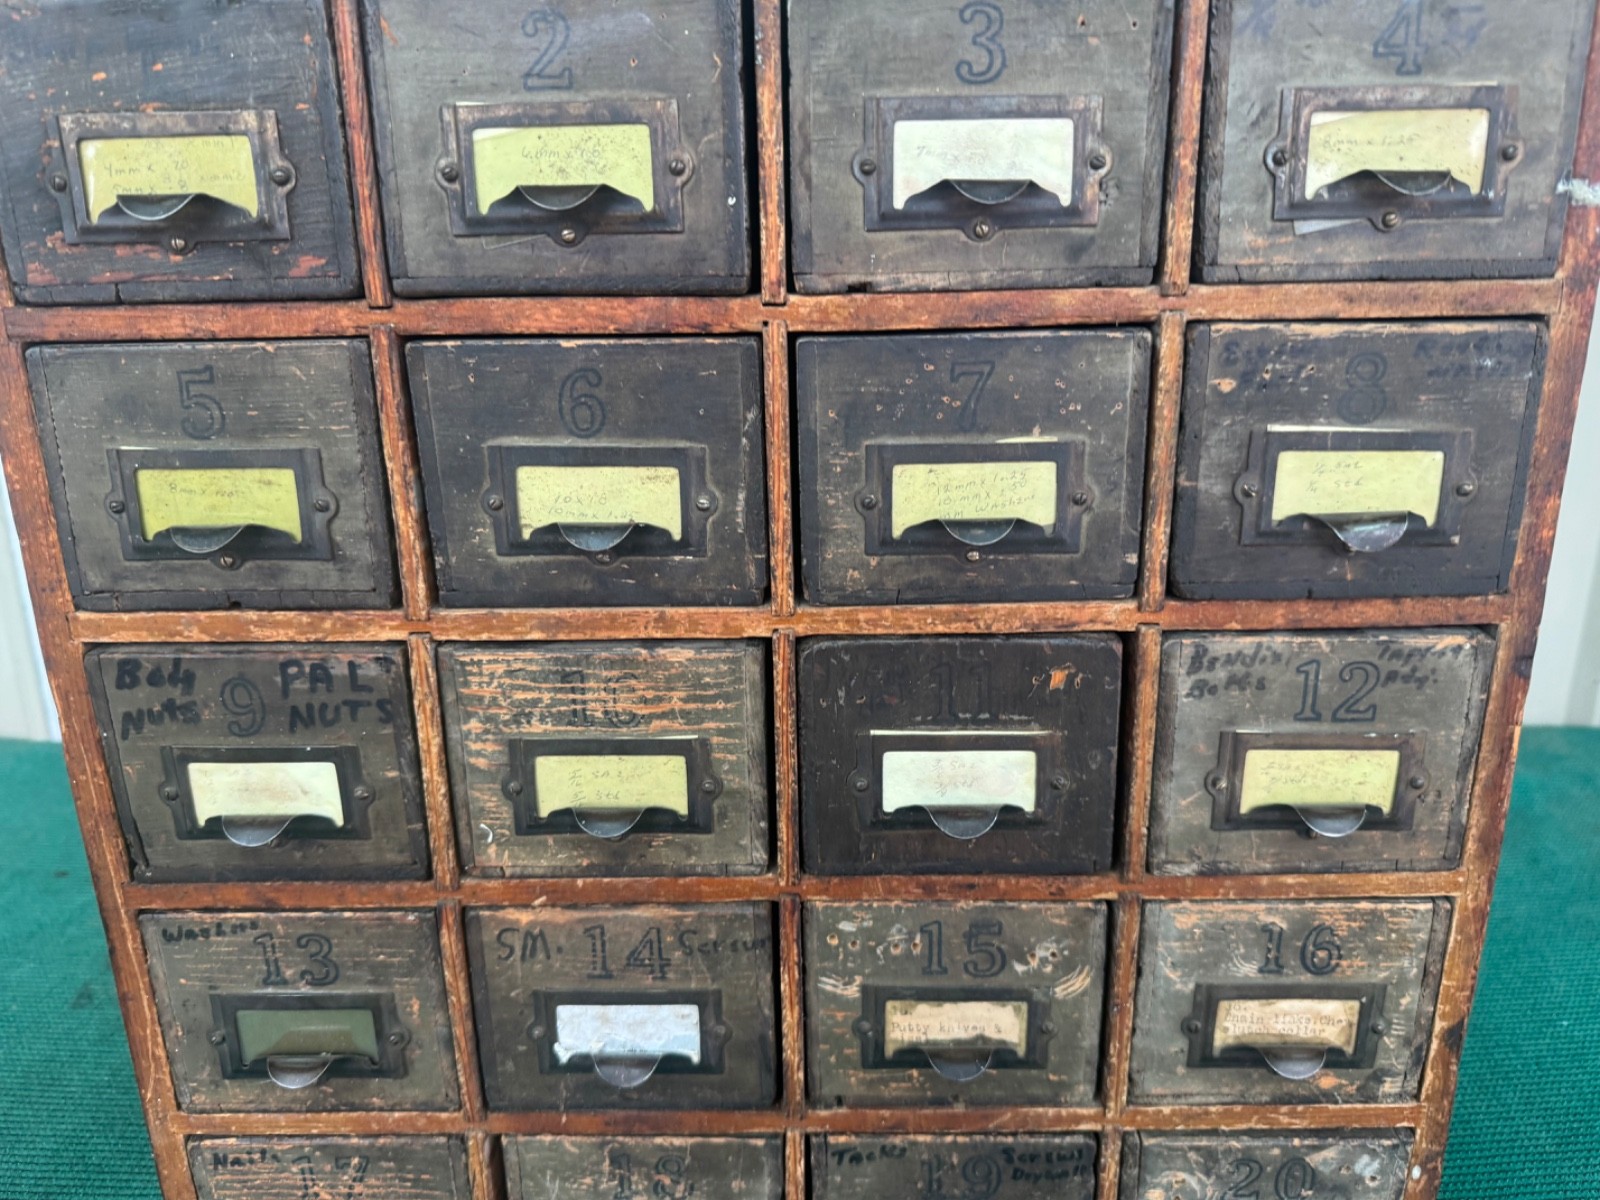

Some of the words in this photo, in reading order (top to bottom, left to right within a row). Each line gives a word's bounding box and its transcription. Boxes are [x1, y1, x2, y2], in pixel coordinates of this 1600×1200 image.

[522, 9, 573, 90] 2
[955, 1, 1007, 85] 3
[1372, 0, 1428, 76] 4
[176, 366, 226, 440] 5
[558, 367, 607, 439] 6
[950, 360, 995, 432] 7
[1337, 352, 1388, 424] 8
[220, 675, 266, 737] 9
[289, 699, 395, 734] NUTS
[928, 660, 996, 726] 11
[1294, 659, 1381, 723] 12
[254, 932, 340, 986] 13
[584, 924, 672, 980] 14
[919, 918, 1008, 979] 15
[1258, 921, 1343, 976] 16
[891, 1021, 930, 1036] Putty
[292, 1155, 370, 1200] 17
[609, 1152, 695, 1200] 18
[921, 1153, 1002, 1200] 19
[1221, 1155, 1316, 1200] 20
